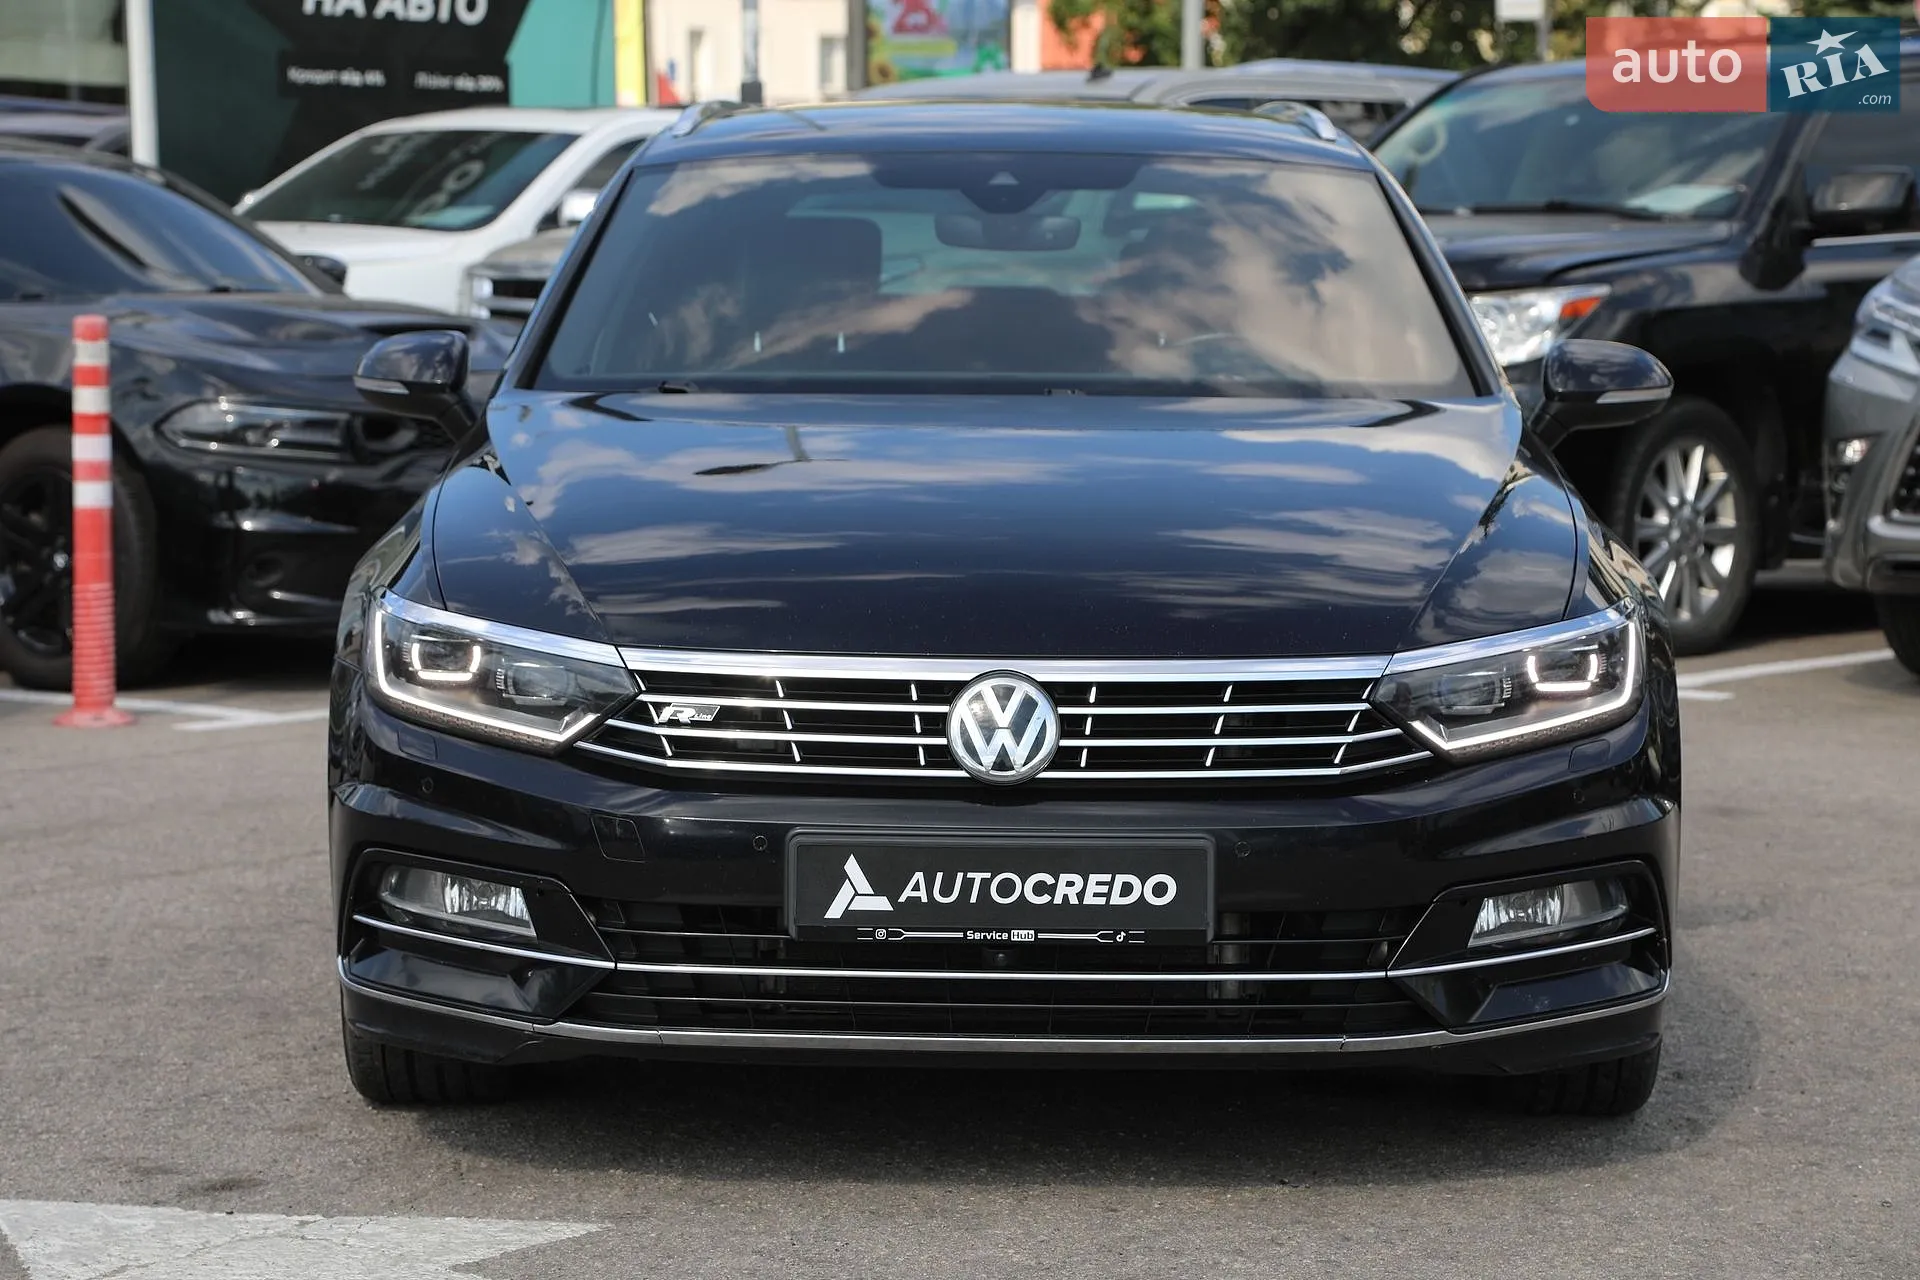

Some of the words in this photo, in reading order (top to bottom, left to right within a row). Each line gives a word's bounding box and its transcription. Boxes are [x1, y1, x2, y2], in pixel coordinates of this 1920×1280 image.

[898, 871, 1178, 906] AUTOCREDO
[966, 930, 1009, 941] Service
[1012, 930, 1035, 941] Hub
